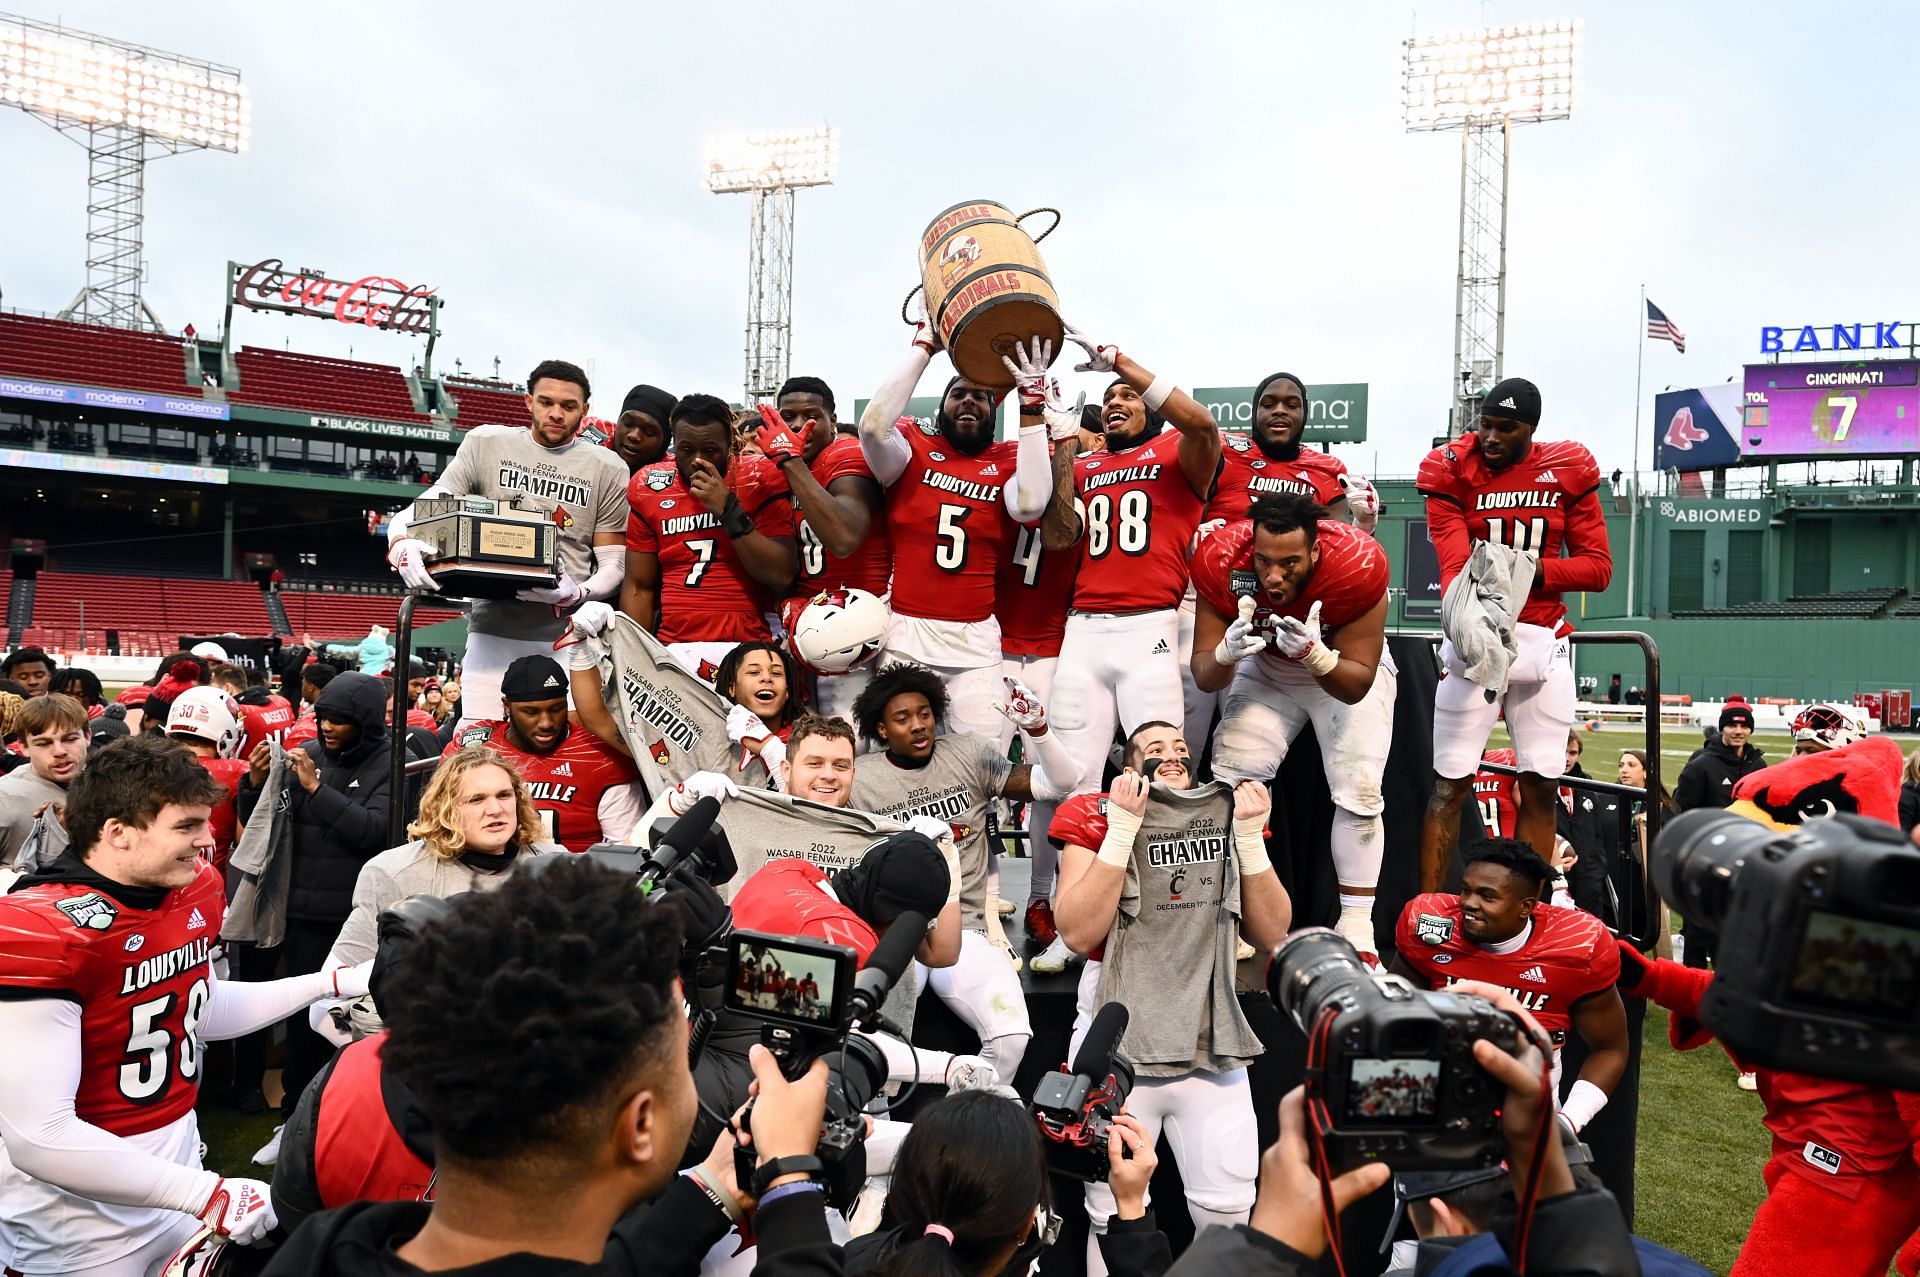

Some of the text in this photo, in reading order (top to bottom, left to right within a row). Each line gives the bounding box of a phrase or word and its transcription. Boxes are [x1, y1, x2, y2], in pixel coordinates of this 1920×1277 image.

[235, 258, 440, 333] Coca-Cola
[940, 272, 1021, 340] CARDINALS
[1760, 321, 1903, 354] BANK
[1806, 371, 1884, 386] CINCINNATI
[0, 381, 66, 399] moderna
[1745, 392, 1769, 403] TOL
[85, 391, 147, 408] moderna
[165, 400, 225, 416] moderna
[1207, 399, 1350, 421] mona
[1827, 396, 1858, 441] 7
[330, 419, 450, 441] BLACK LIVES MATTER
[500, 459, 593, 488] WASABI FENWAY BOWL
[535, 462, 558, 472] 2022
[921, 468, 1001, 502] LOUISVILLE
[1083, 464, 1161, 493] LOUISVILLE
[499, 468, 592, 508] CHAMPION
[1475, 490, 1561, 510] LOUISVILLE
[1087, 490, 1148, 557] 88
[1675, 508, 1761, 523] ABIOMED
[935, 504, 968, 569] 5
[685, 539, 714, 585] 7
[1231, 579, 1258, 591] BOWL
[1579, 676, 1598, 688] 379
[625, 666, 656, 692] WASABI
[654, 689, 686, 717] FENWAY
[661, 685, 682, 704] 2022
[551, 768, 574, 777] adidas
[872, 783, 968, 816] WASABI FENWAY BOWL
[907, 786, 930, 798] 2022
[1189, 818, 1214, 829] 2022
[1147, 827, 1226, 842] WASABI FENWAY
[766, 848, 805, 860] WASABI
[807, 852, 847, 865] FENWAY
[810, 843, 836, 855] 2022
[1200, 877, 1216, 886] VS.
[70, 901, 117, 926] BOWL
[1156, 903, 1196, 911] DECEMBER
[186, 919, 207, 930] adidas
[1417, 923, 1450, 939] BOWL
[127, 938, 142, 950] ACC
[120, 936, 210, 995] LOUISVILLE
[1519, 973, 1547, 984] adidas
[234, 1184, 249, 1222] adidas
